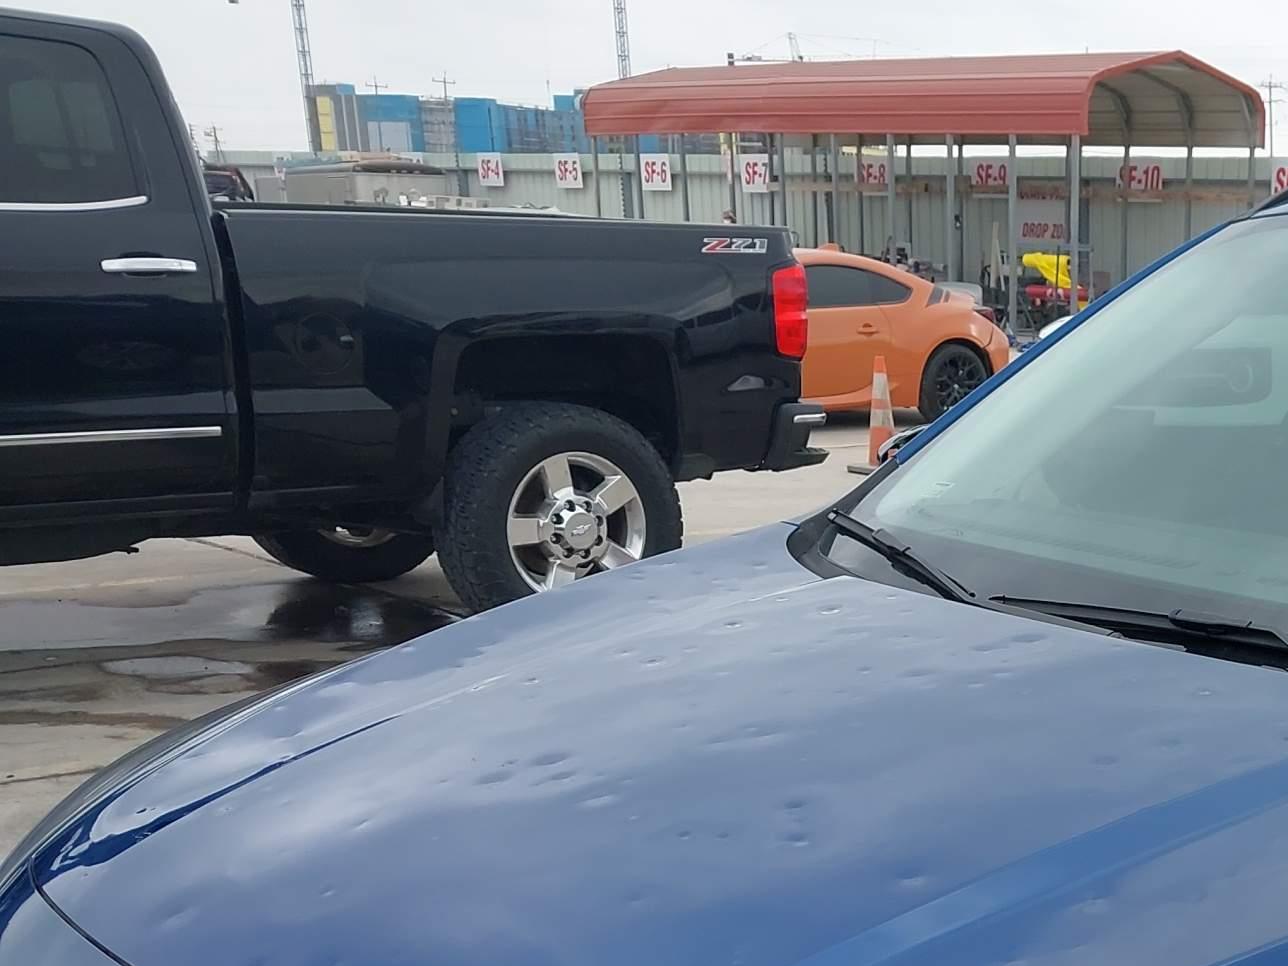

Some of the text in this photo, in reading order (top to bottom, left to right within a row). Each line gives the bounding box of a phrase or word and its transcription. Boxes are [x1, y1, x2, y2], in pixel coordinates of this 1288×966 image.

[480, 159, 500, 180] SF-4
[557, 160, 578, 181] SF-5
[644, 161, 667, 184] SF-6
[744, 161, 768, 185] SF-7
[976, 163, 1007, 185] SF-9
[701, 237, 768, 254] Z71
